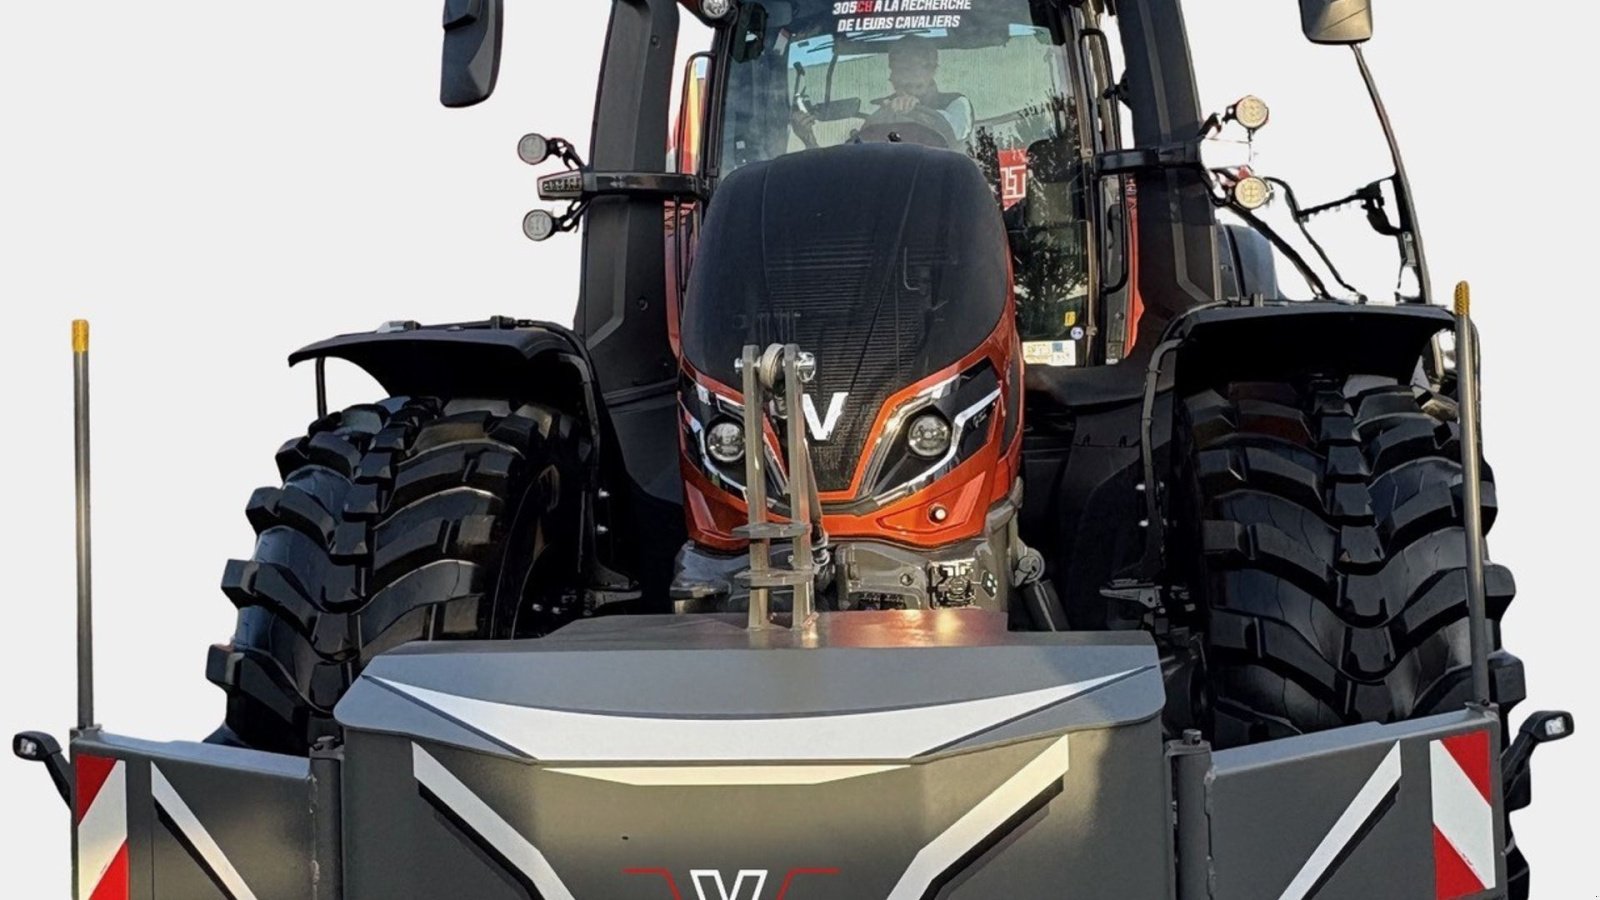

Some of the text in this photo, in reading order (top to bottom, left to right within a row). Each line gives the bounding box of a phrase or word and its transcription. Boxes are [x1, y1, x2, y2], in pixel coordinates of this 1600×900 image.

[884, 0, 898, 12] LA
[900, 0, 972, 11] RECHERCHE
[837, 15, 960, 32] DE LEURS CAVALIERS
[802, 392, 849, 440] V
